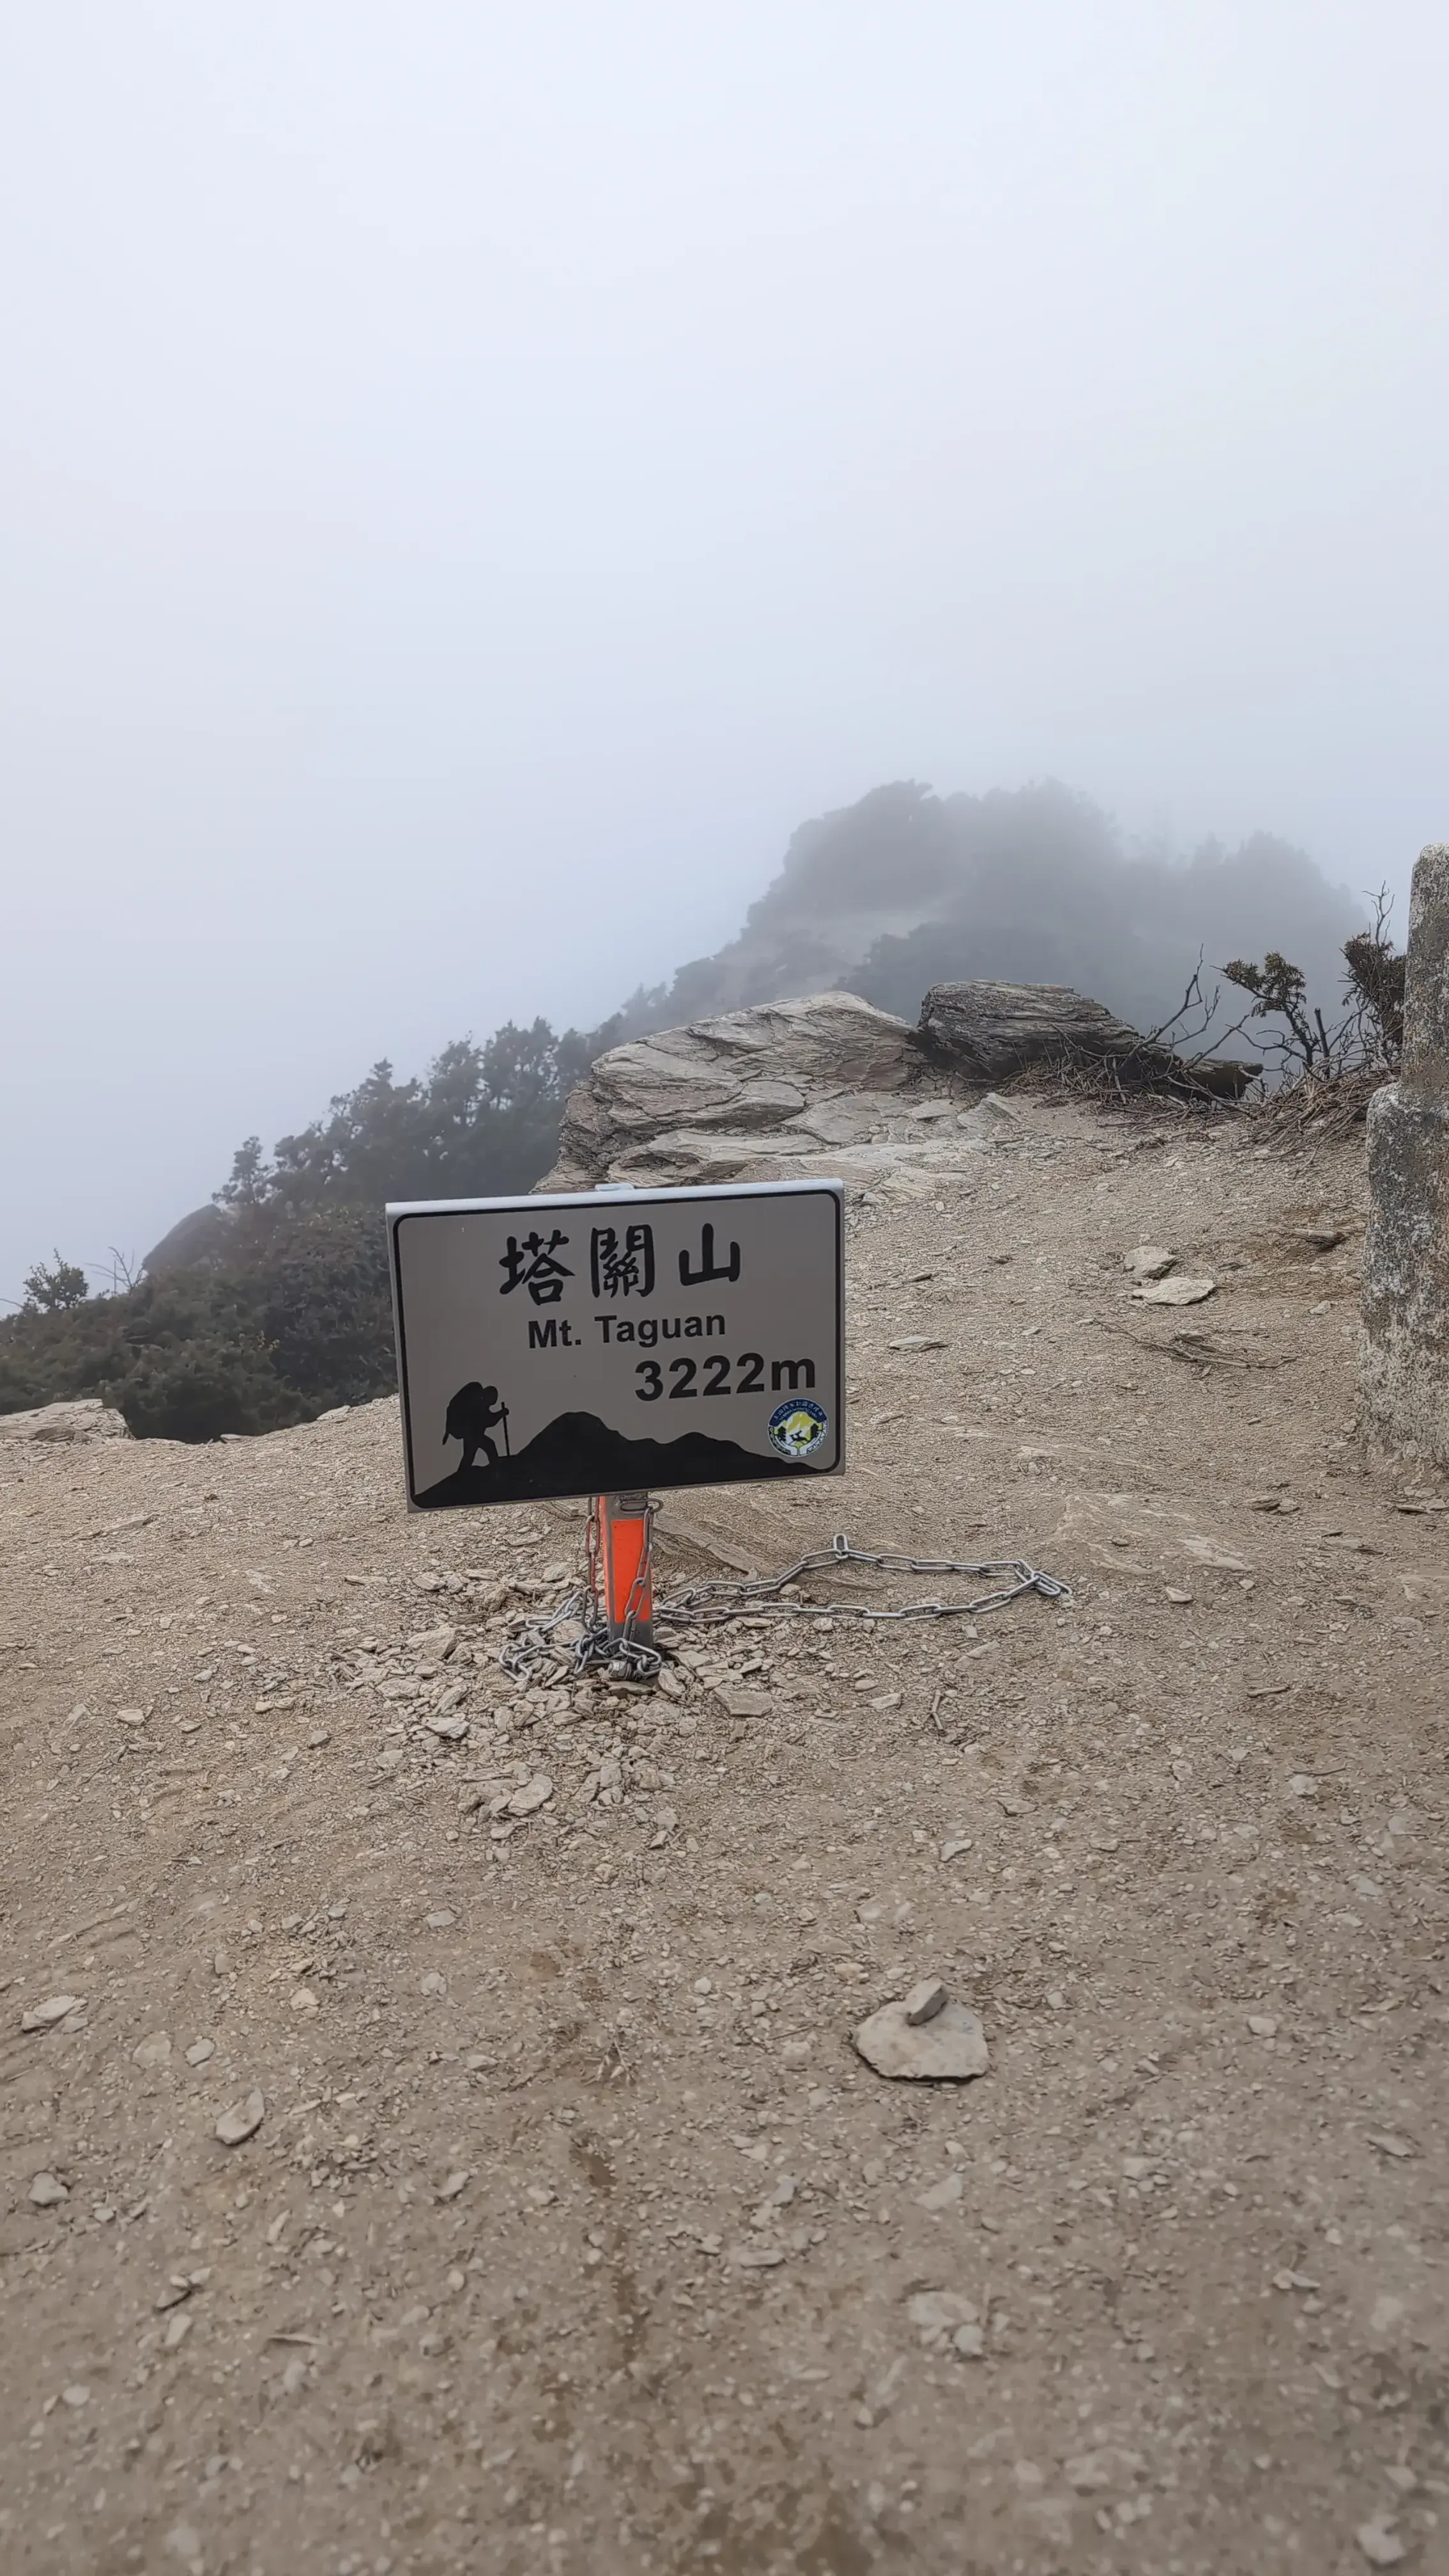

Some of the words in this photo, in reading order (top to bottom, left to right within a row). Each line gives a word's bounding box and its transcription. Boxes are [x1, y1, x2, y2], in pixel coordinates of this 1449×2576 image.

[498, 1223, 740, 1306] 塔關山
[528, 1319, 582, 1349] Mt.
[594, 1314, 726, 1348] Taguan
[634, 1353, 816, 1402] 3222m
